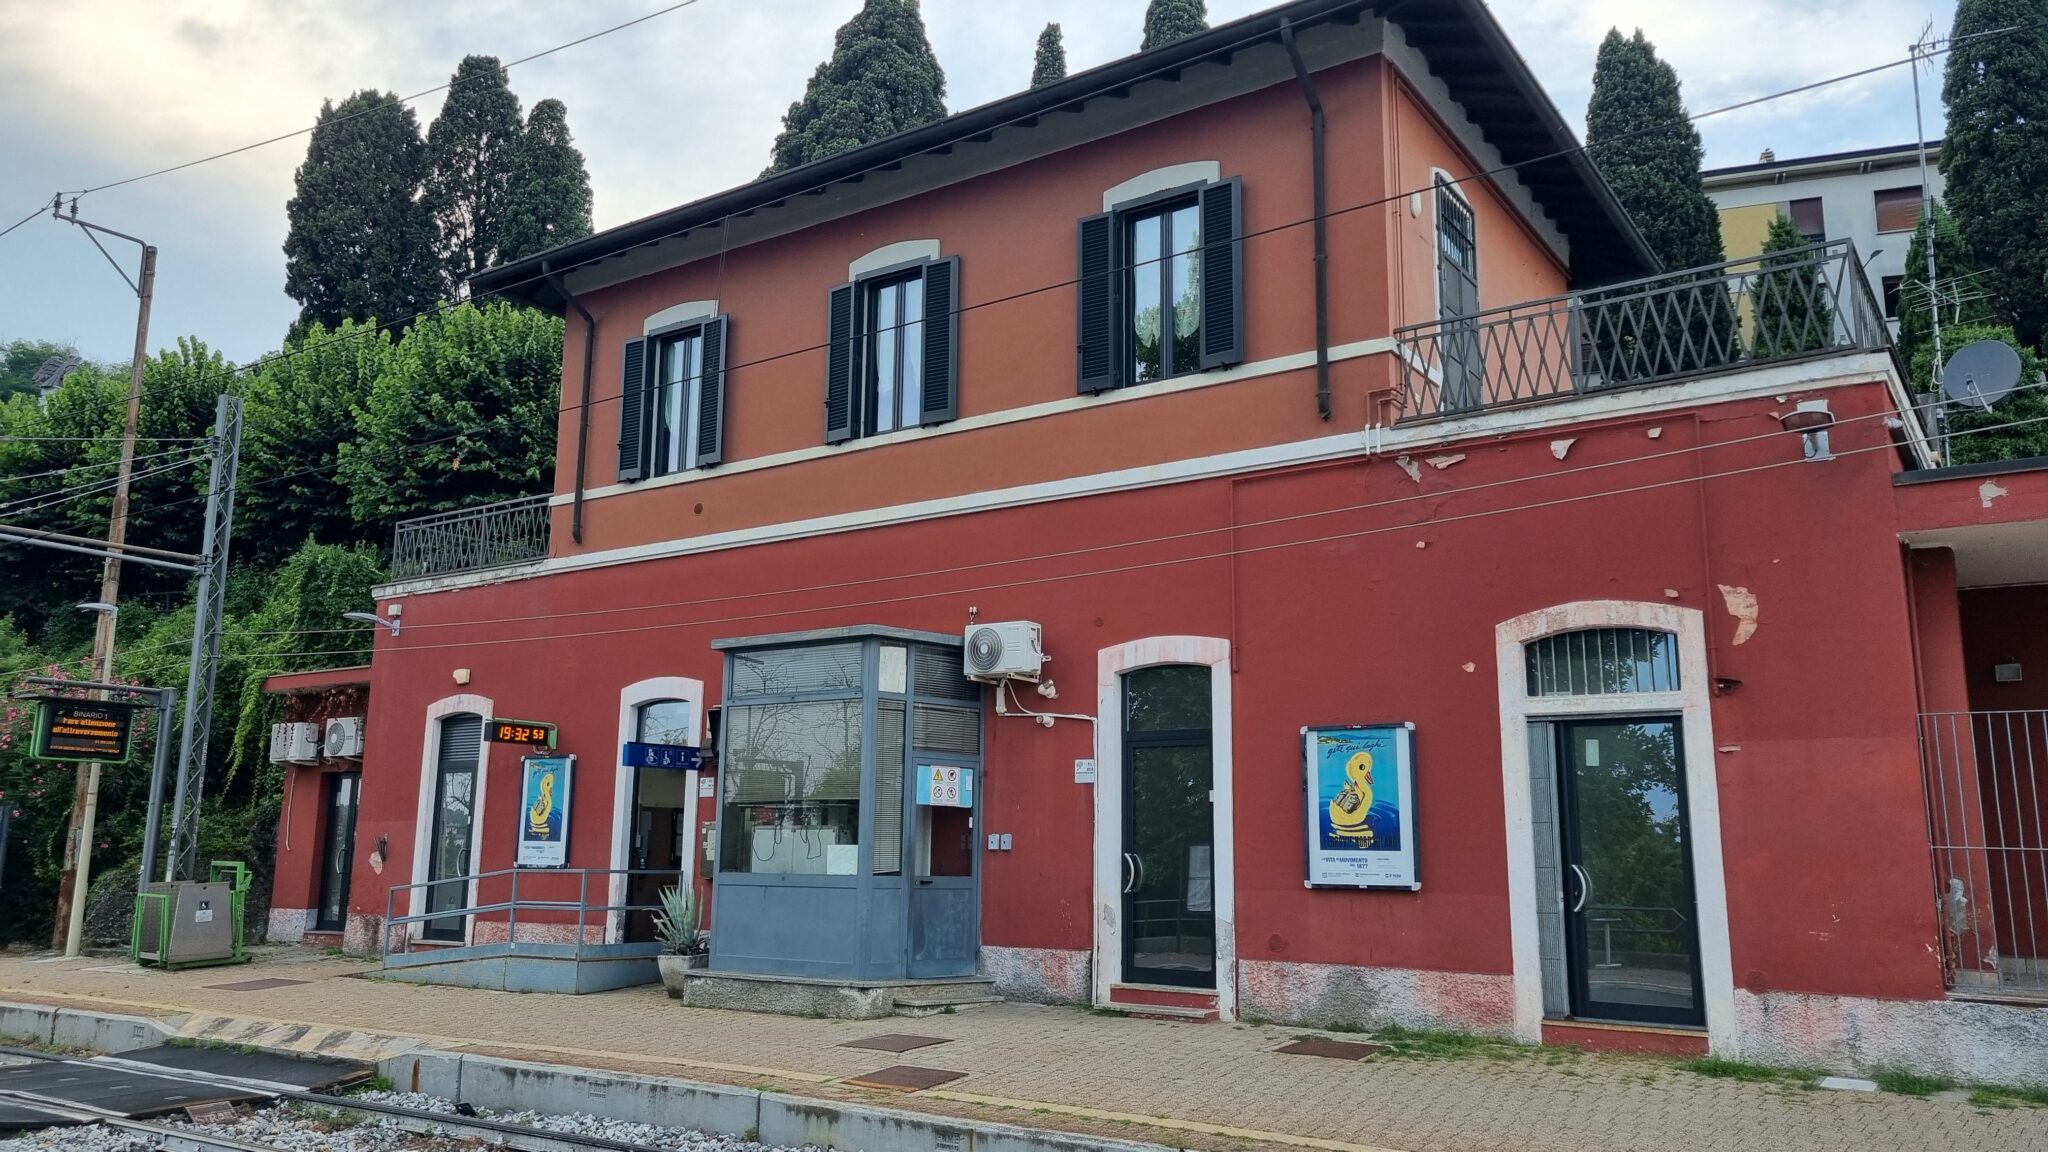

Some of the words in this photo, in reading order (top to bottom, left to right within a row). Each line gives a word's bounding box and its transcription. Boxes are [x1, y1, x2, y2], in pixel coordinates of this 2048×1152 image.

[73, 710, 103, 719] BINARIO
[499, 726, 529, 741] 19:32
[533, 729, 545, 740] 53
